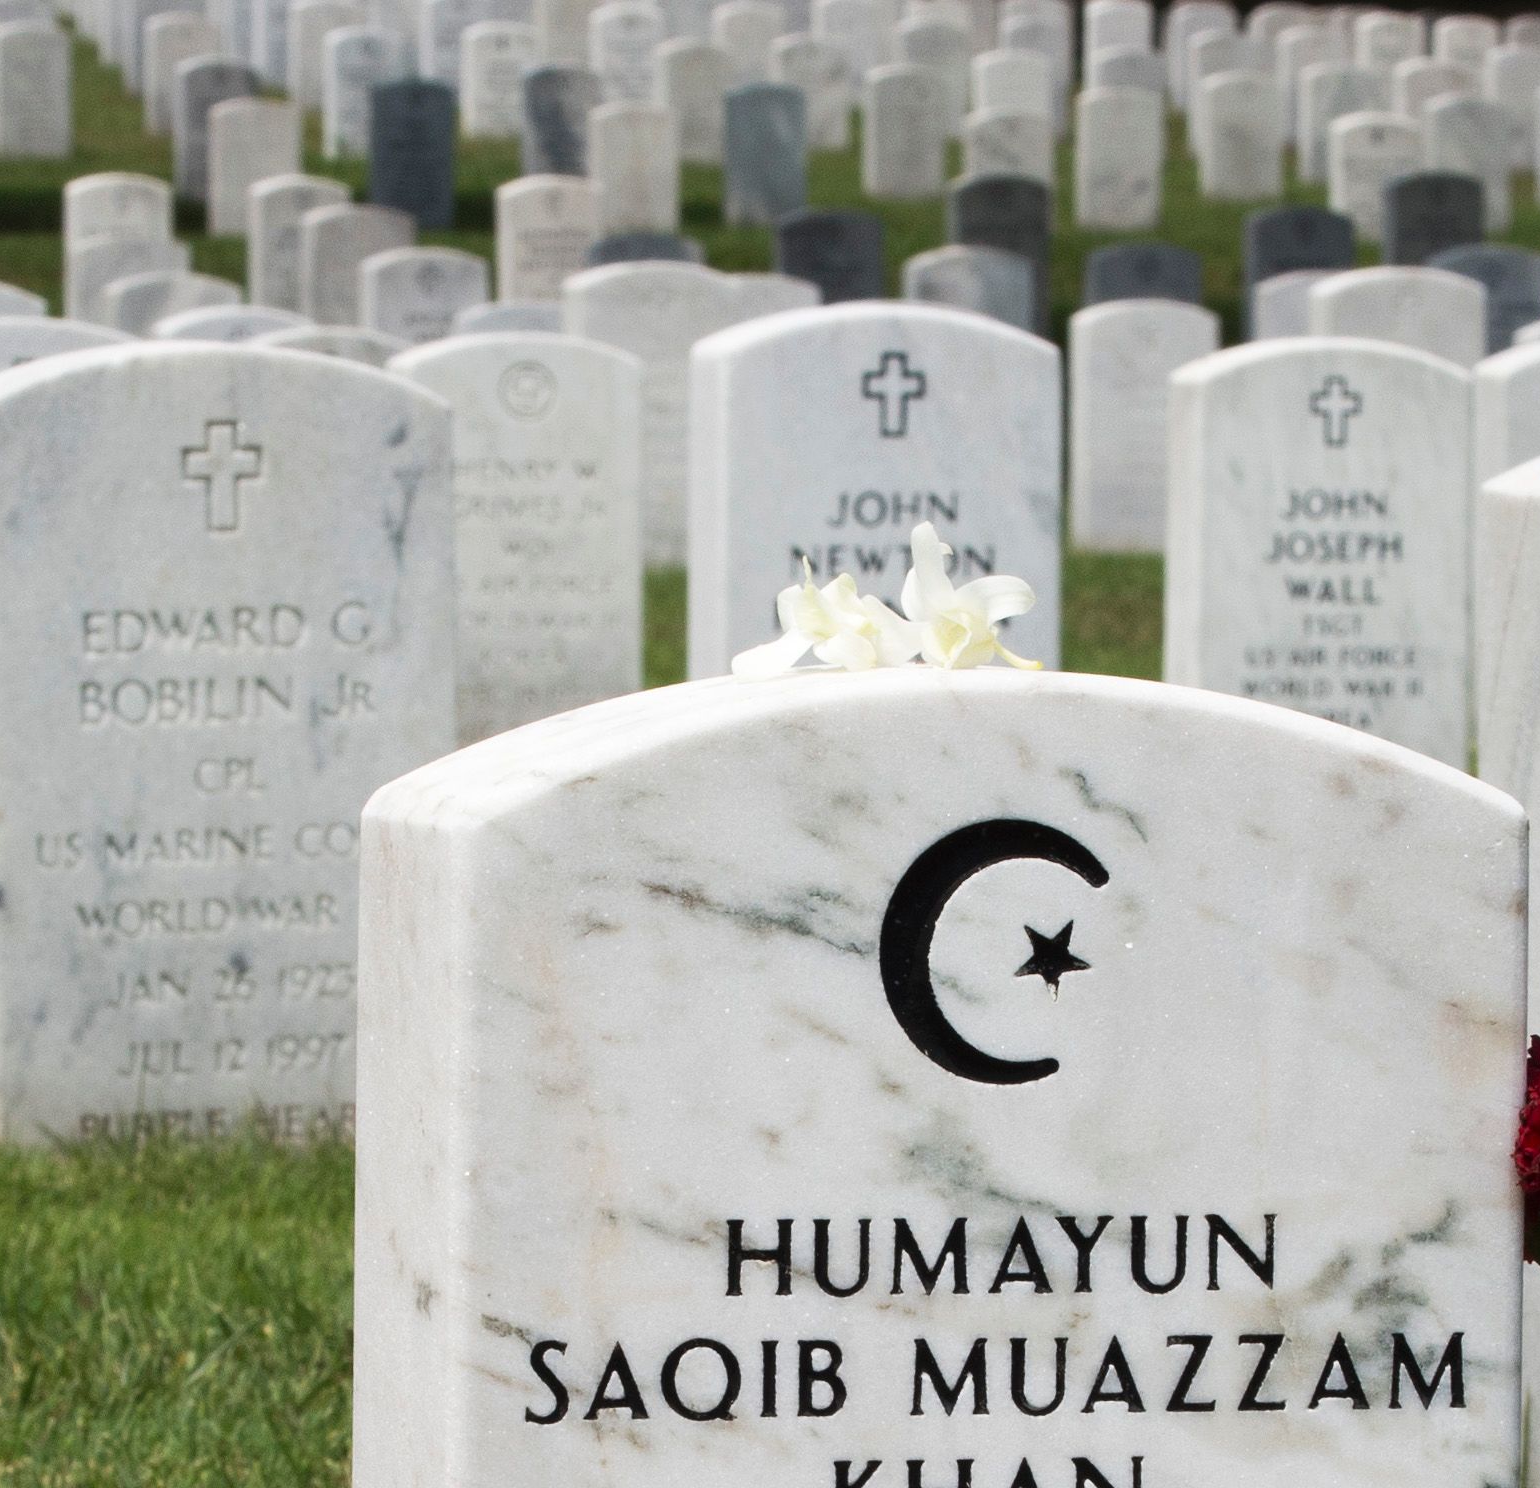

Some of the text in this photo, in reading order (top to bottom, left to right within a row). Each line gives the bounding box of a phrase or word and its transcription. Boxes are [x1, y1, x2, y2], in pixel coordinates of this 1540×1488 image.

[826, 489, 961, 527] JOHN
[1283, 488, 1389, 521] JOHN
[787, 543, 998, 580] NEWTN
[1264, 531, 1404, 564] JOSEPH
[1285, 574, 1381, 605] WALL
[82, 605, 306, 653] EDWARD
[79, 674, 293, 726] BOBILIN
[193, 756, 265, 792] CPL
[35, 829, 83, 867] US
[99, 824, 275, 863] MARINE
[75, 892, 340, 939] WORLD WAR
[108, 970, 192, 1009] JAN
[117, 1037, 191, 1076] JUL
[723, 1212, 1277, 1298] HUMAYUN
[524, 1330, 1468, 1426] SAQIB MUAZZAM
